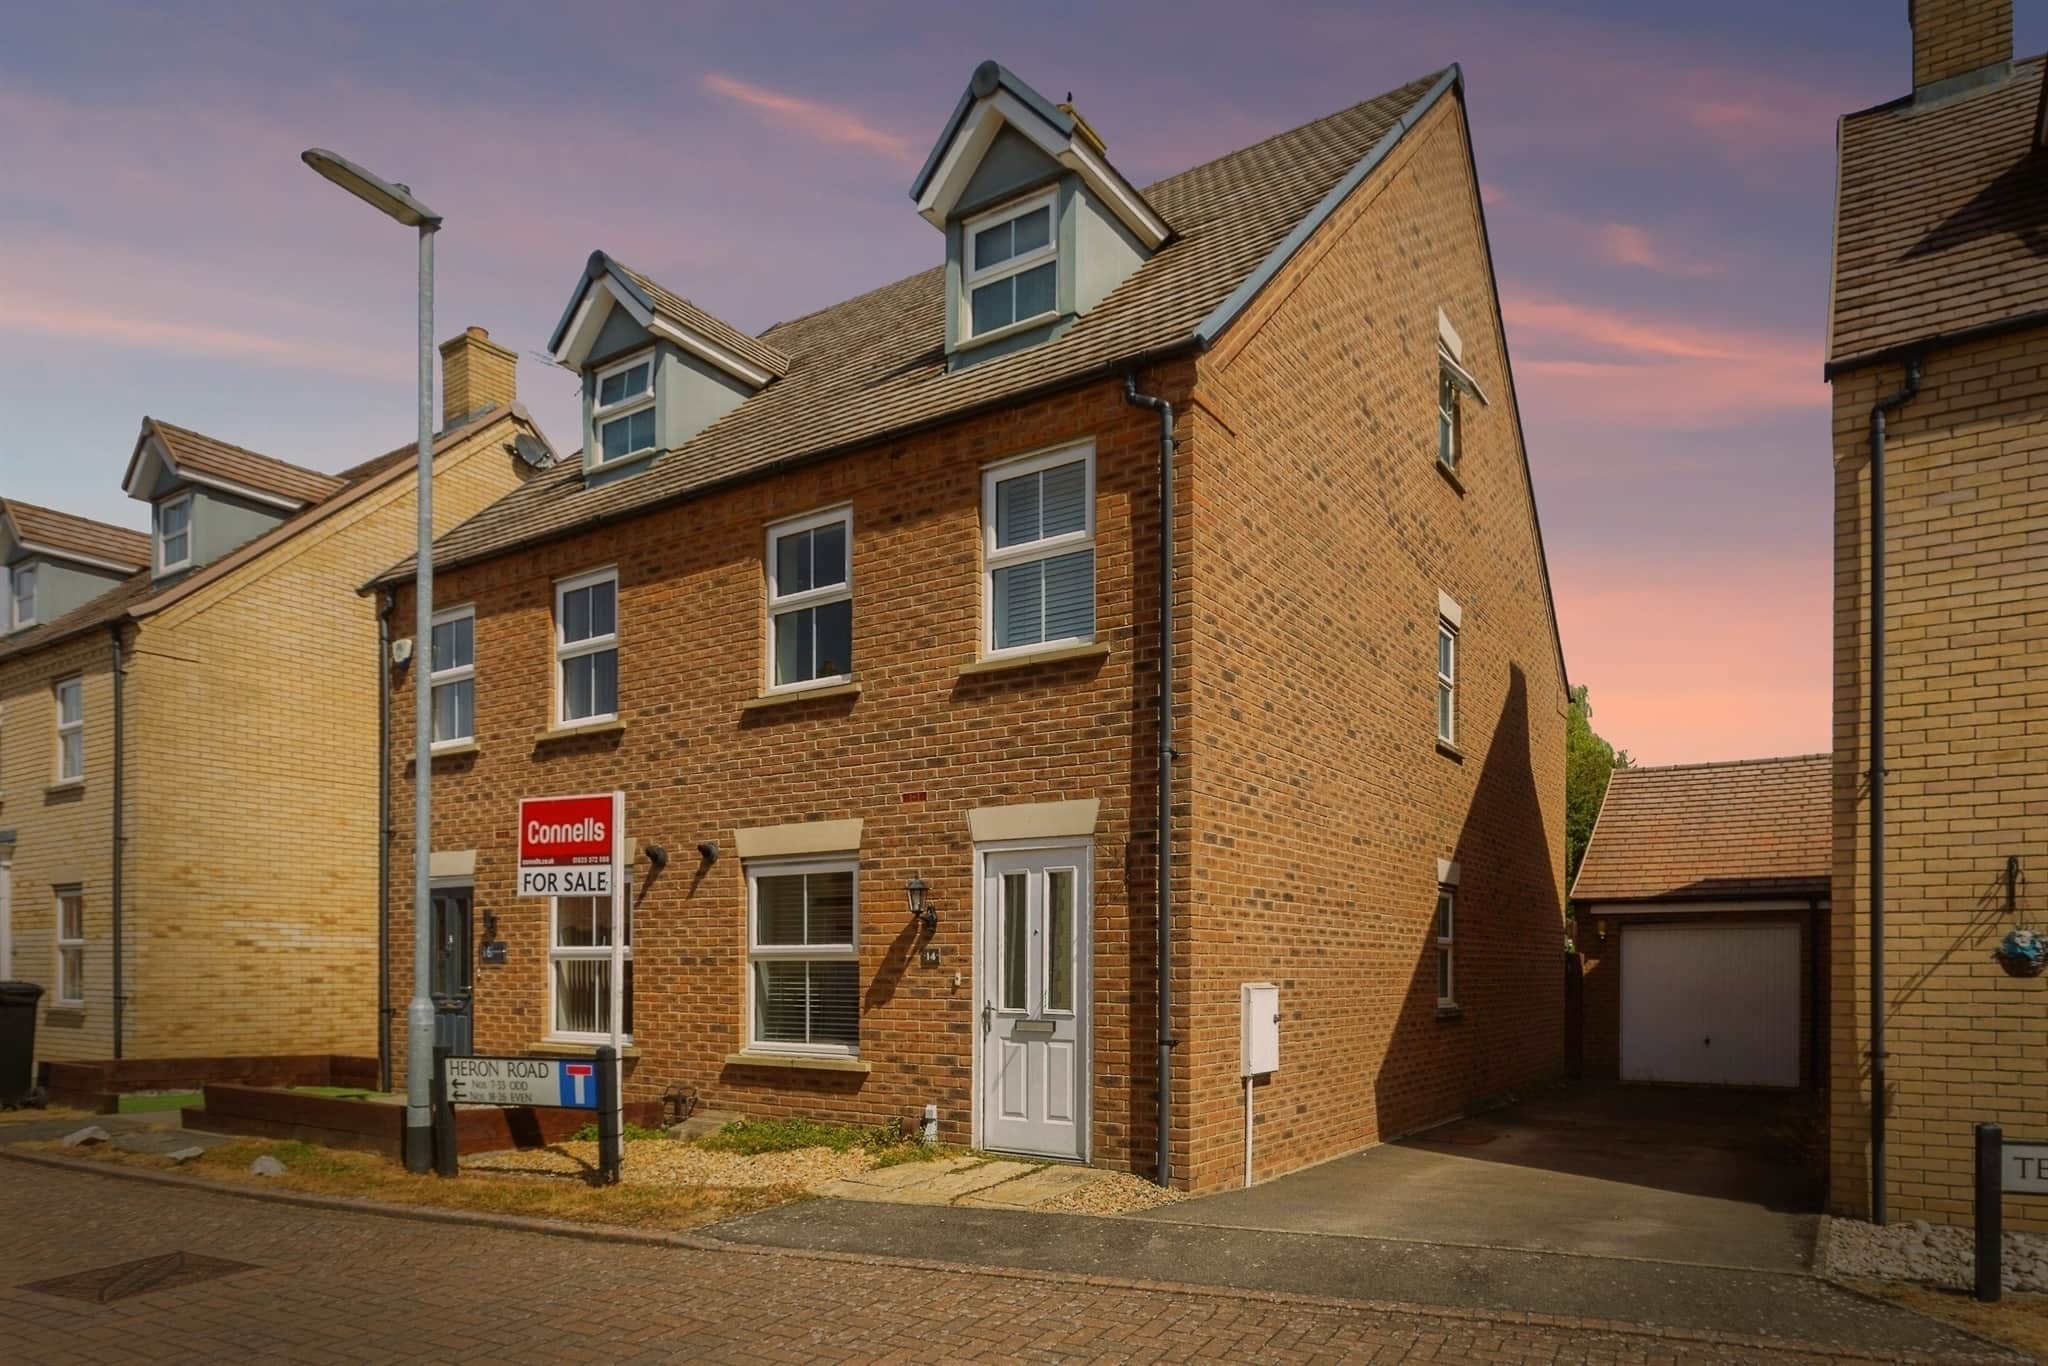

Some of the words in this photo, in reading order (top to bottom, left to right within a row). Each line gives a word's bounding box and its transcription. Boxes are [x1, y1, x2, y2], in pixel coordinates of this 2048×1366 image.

[528, 817, 605, 844] Connells
[523, 872, 558, 892] FOR
[564, 871, 607, 892] SALE
[926, 951, 937, 961] 14
[450, 1060, 499, 1077] HERON
[507, 1061, 549, 1078] ROAD
[509, 1080, 529, 1091] ODD
[510, 1092, 533, 1103] EVEN
